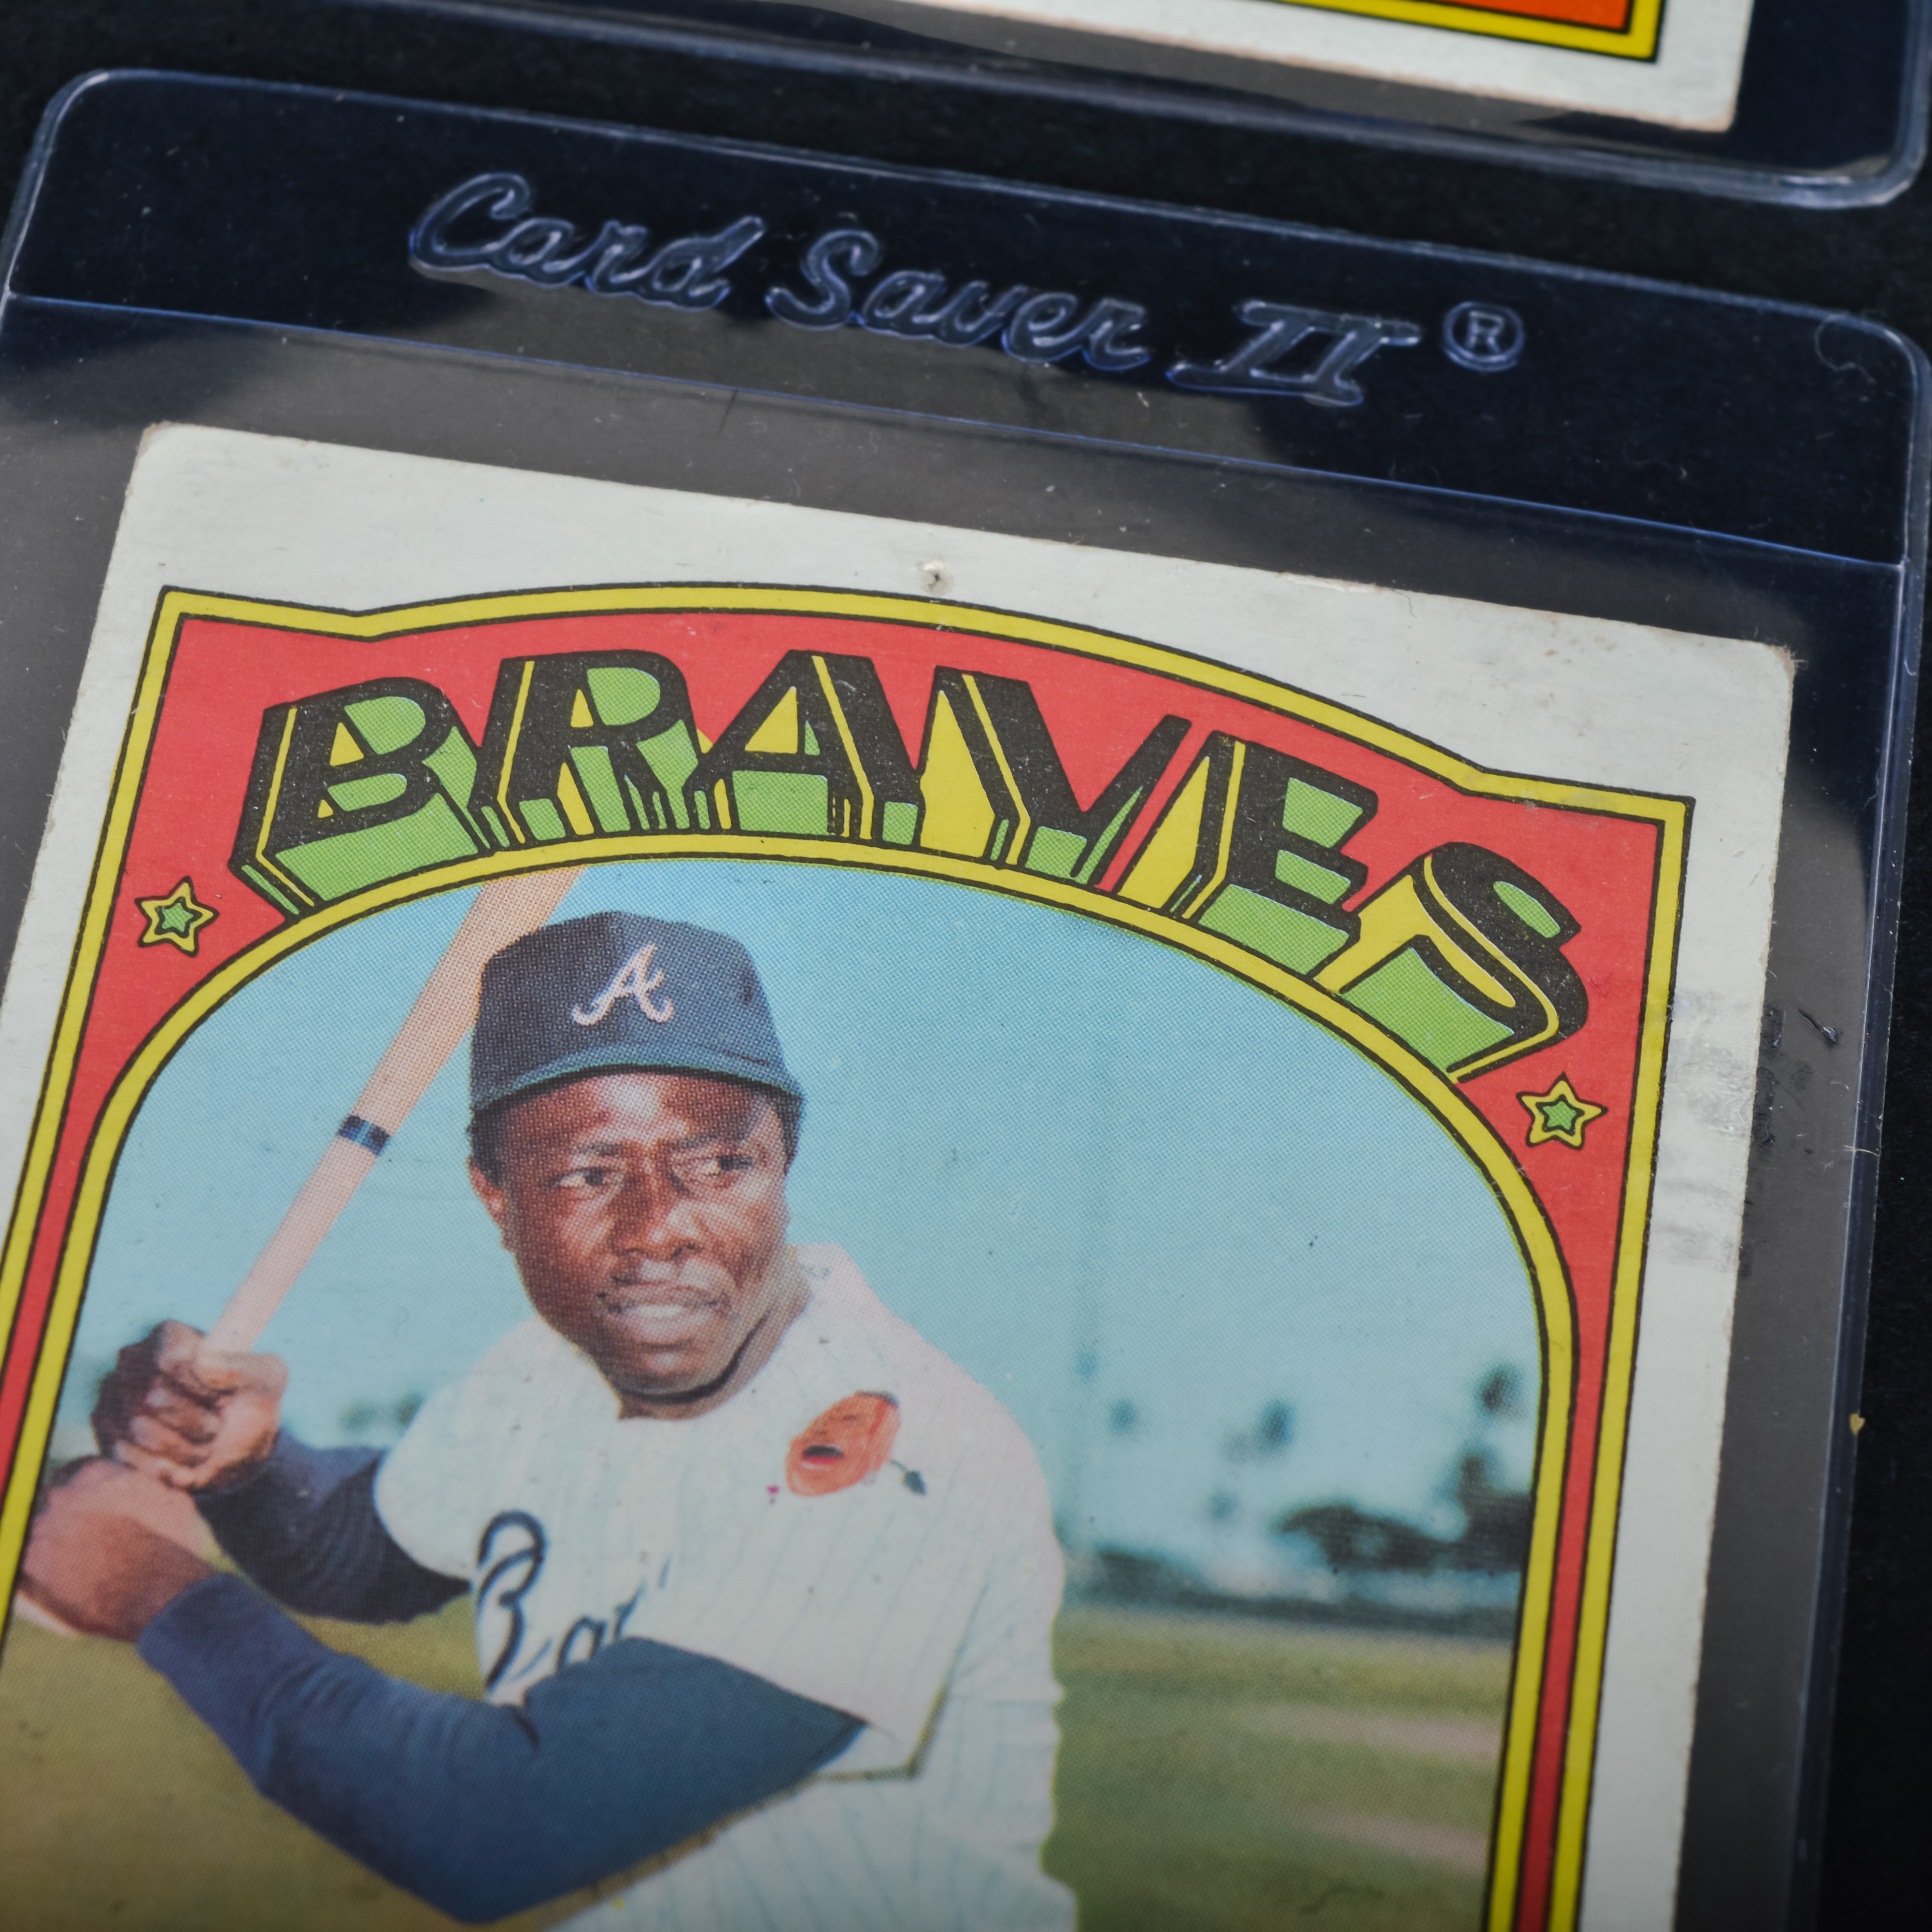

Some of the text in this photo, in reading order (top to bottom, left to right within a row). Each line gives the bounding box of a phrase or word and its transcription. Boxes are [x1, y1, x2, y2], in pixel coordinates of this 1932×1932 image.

[409, 172, 764, 312] Card
[765, 229, 1151, 370] Saver
[228, 648, 1589, 1082] BRAVES
[571, 944, 675, 1026] A
